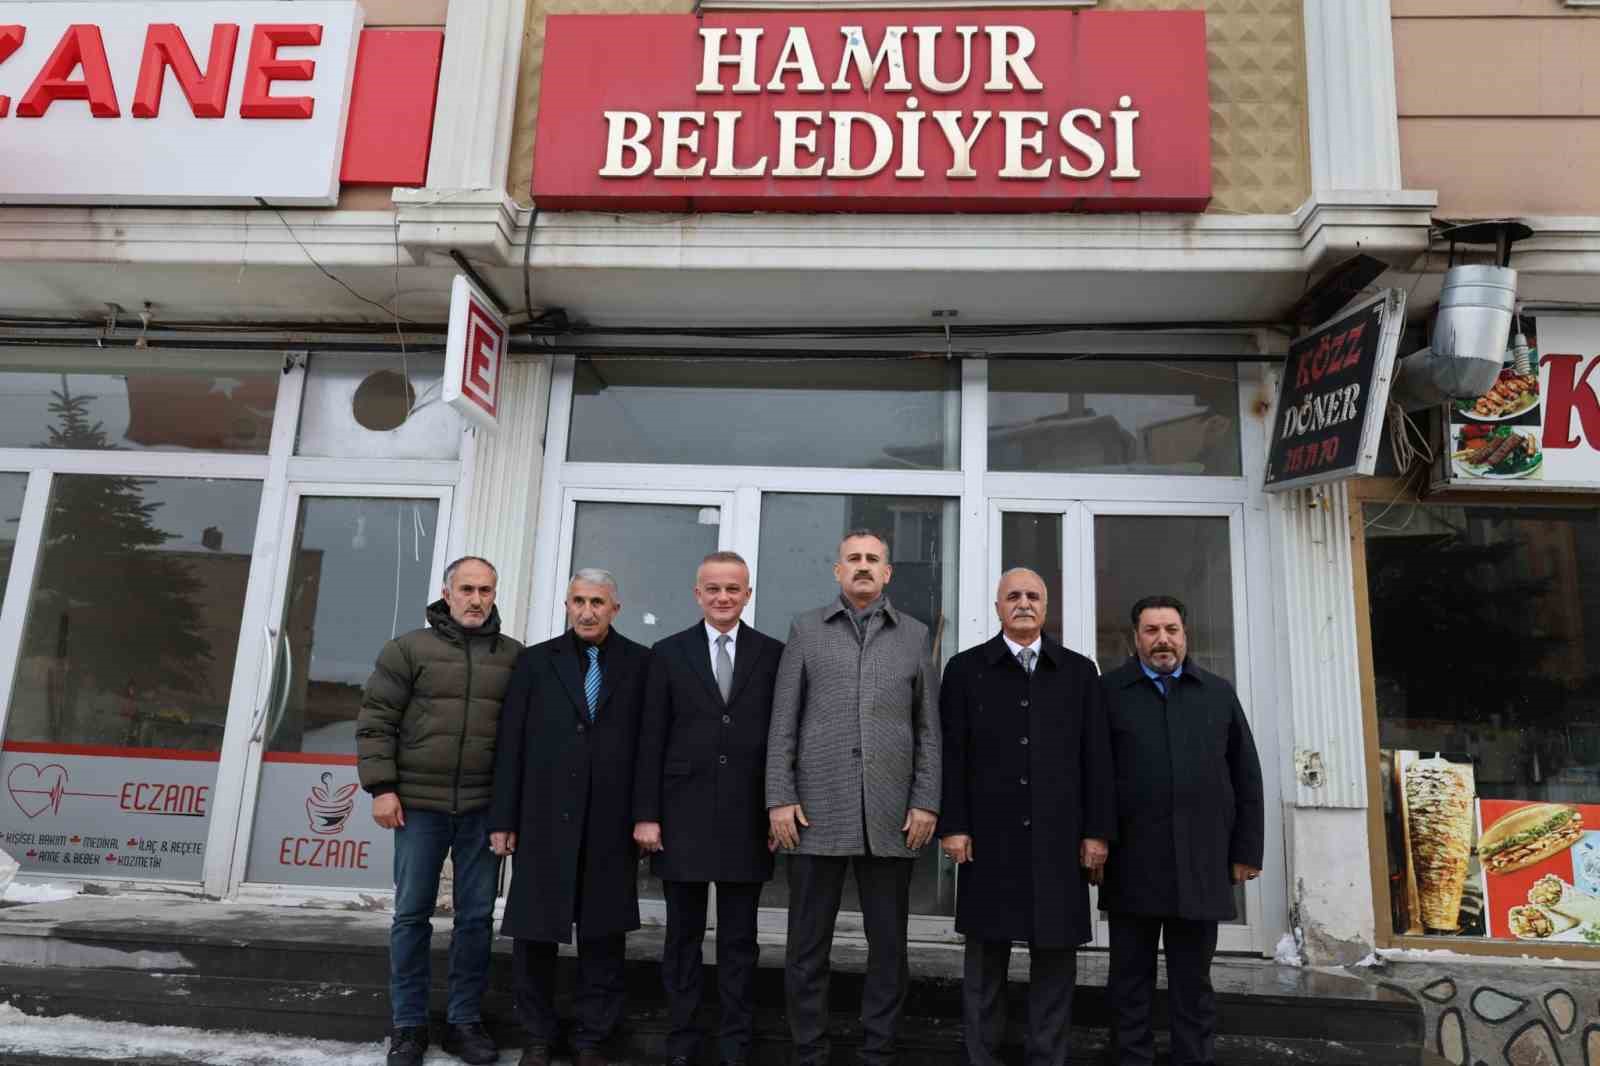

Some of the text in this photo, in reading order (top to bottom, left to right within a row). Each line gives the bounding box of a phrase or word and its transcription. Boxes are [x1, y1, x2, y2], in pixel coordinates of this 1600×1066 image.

[695, 24, 1044, 93] HAMUR
[598, 95, 1141, 180] BELEDİYESİ
[1281, 382, 1361, 440] DÖNER
[120, 782, 209, 814] ECZANE
[279, 836, 372, 870] ECZANE
